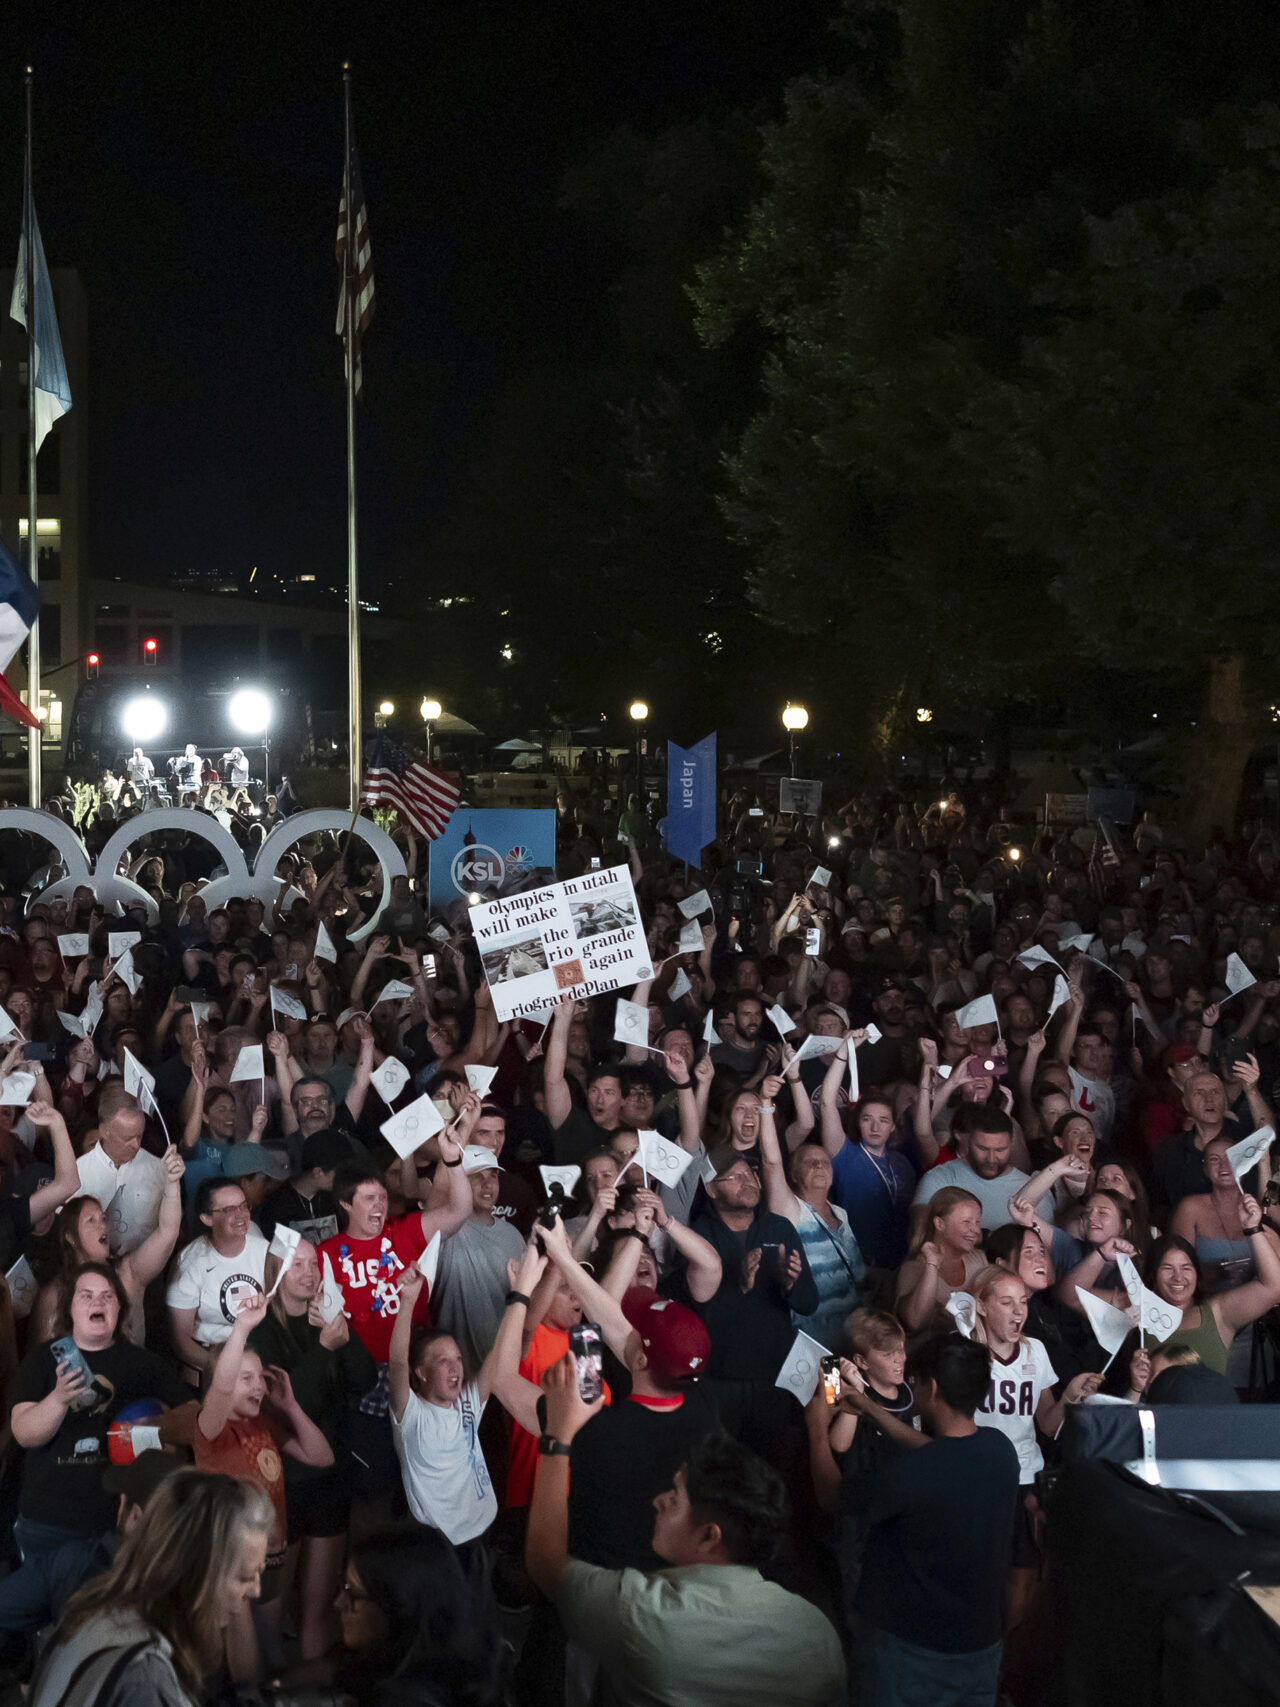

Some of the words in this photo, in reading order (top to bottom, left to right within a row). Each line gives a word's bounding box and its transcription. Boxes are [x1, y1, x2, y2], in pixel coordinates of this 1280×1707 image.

[680, 759, 696, 809] Japan
[457, 861, 501, 882] KSL
[488, 889, 555, 917] olympics
[562, 882, 578, 896] in
[582, 869, 619, 892] utah
[479, 914, 511, 939] will
[515, 905, 558, 929] make
[543, 928, 569, 944] the
[548, 945, 573, 962] rio
[582, 929, 635, 959] grande
[589, 949, 634, 970] again
